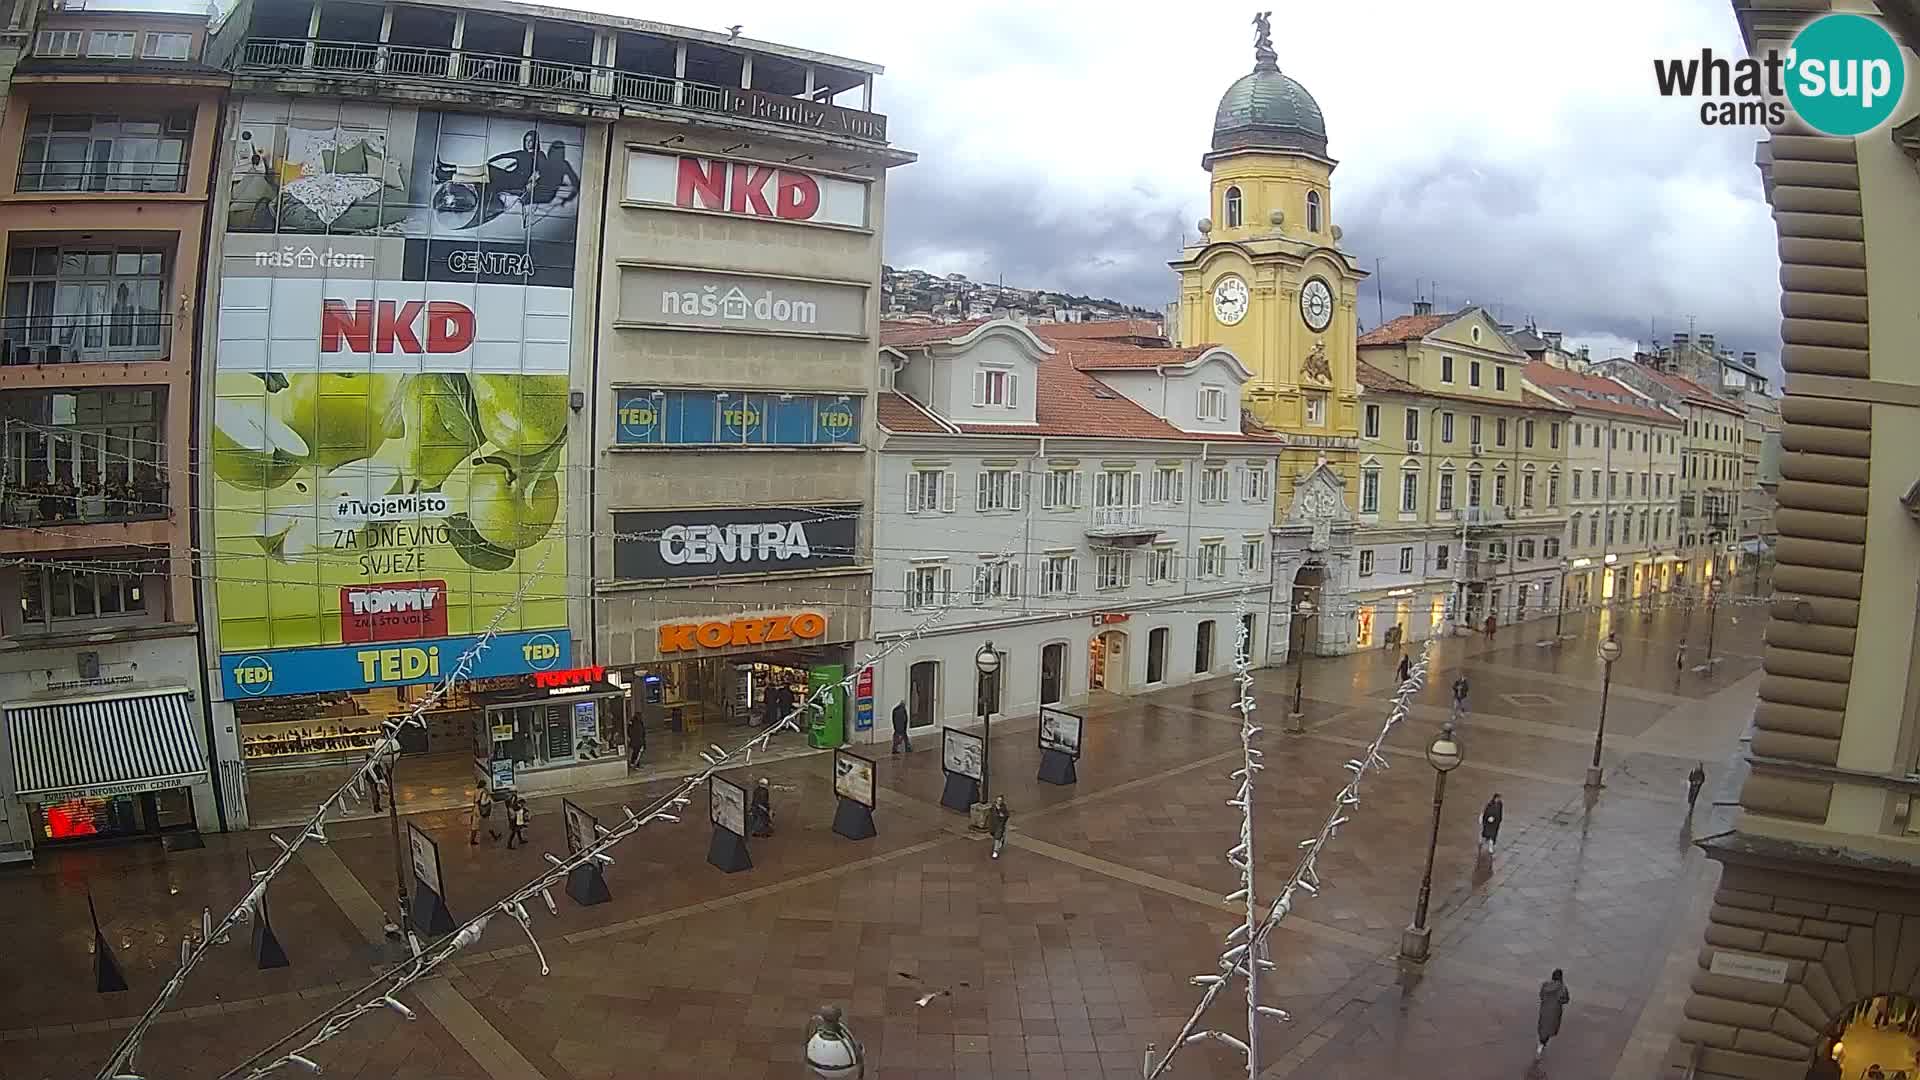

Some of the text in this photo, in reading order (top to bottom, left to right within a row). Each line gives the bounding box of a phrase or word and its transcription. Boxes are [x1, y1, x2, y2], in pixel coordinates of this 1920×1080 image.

[724, 89, 745, 112] Le
[676, 158, 821, 220] NKD
[255, 246, 366, 270] naš dom
[448, 251, 535, 276] CENTRA
[662, 285, 816, 323] naš dom
[320, 298, 477, 354] NKD
[619, 408, 657, 426] TEDi
[724, 410, 759, 426] TEDi
[820, 412, 852, 428] TEDi
[338, 497, 446, 517] #TvojeMisto
[334, 525, 450, 549] ZA DNEVNO
[659, 521, 810, 565] CENTRA
[360, 548, 426, 575] SVJEŽE
[349, 587, 440, 615] TOMMY
[659, 613, 826, 653] KORZO
[522, 642, 560, 662] TEDi
[234, 667, 273, 684] TEDi
[358, 646, 439, 683] TEDi
[150, 778, 183, 790] CENTAR
